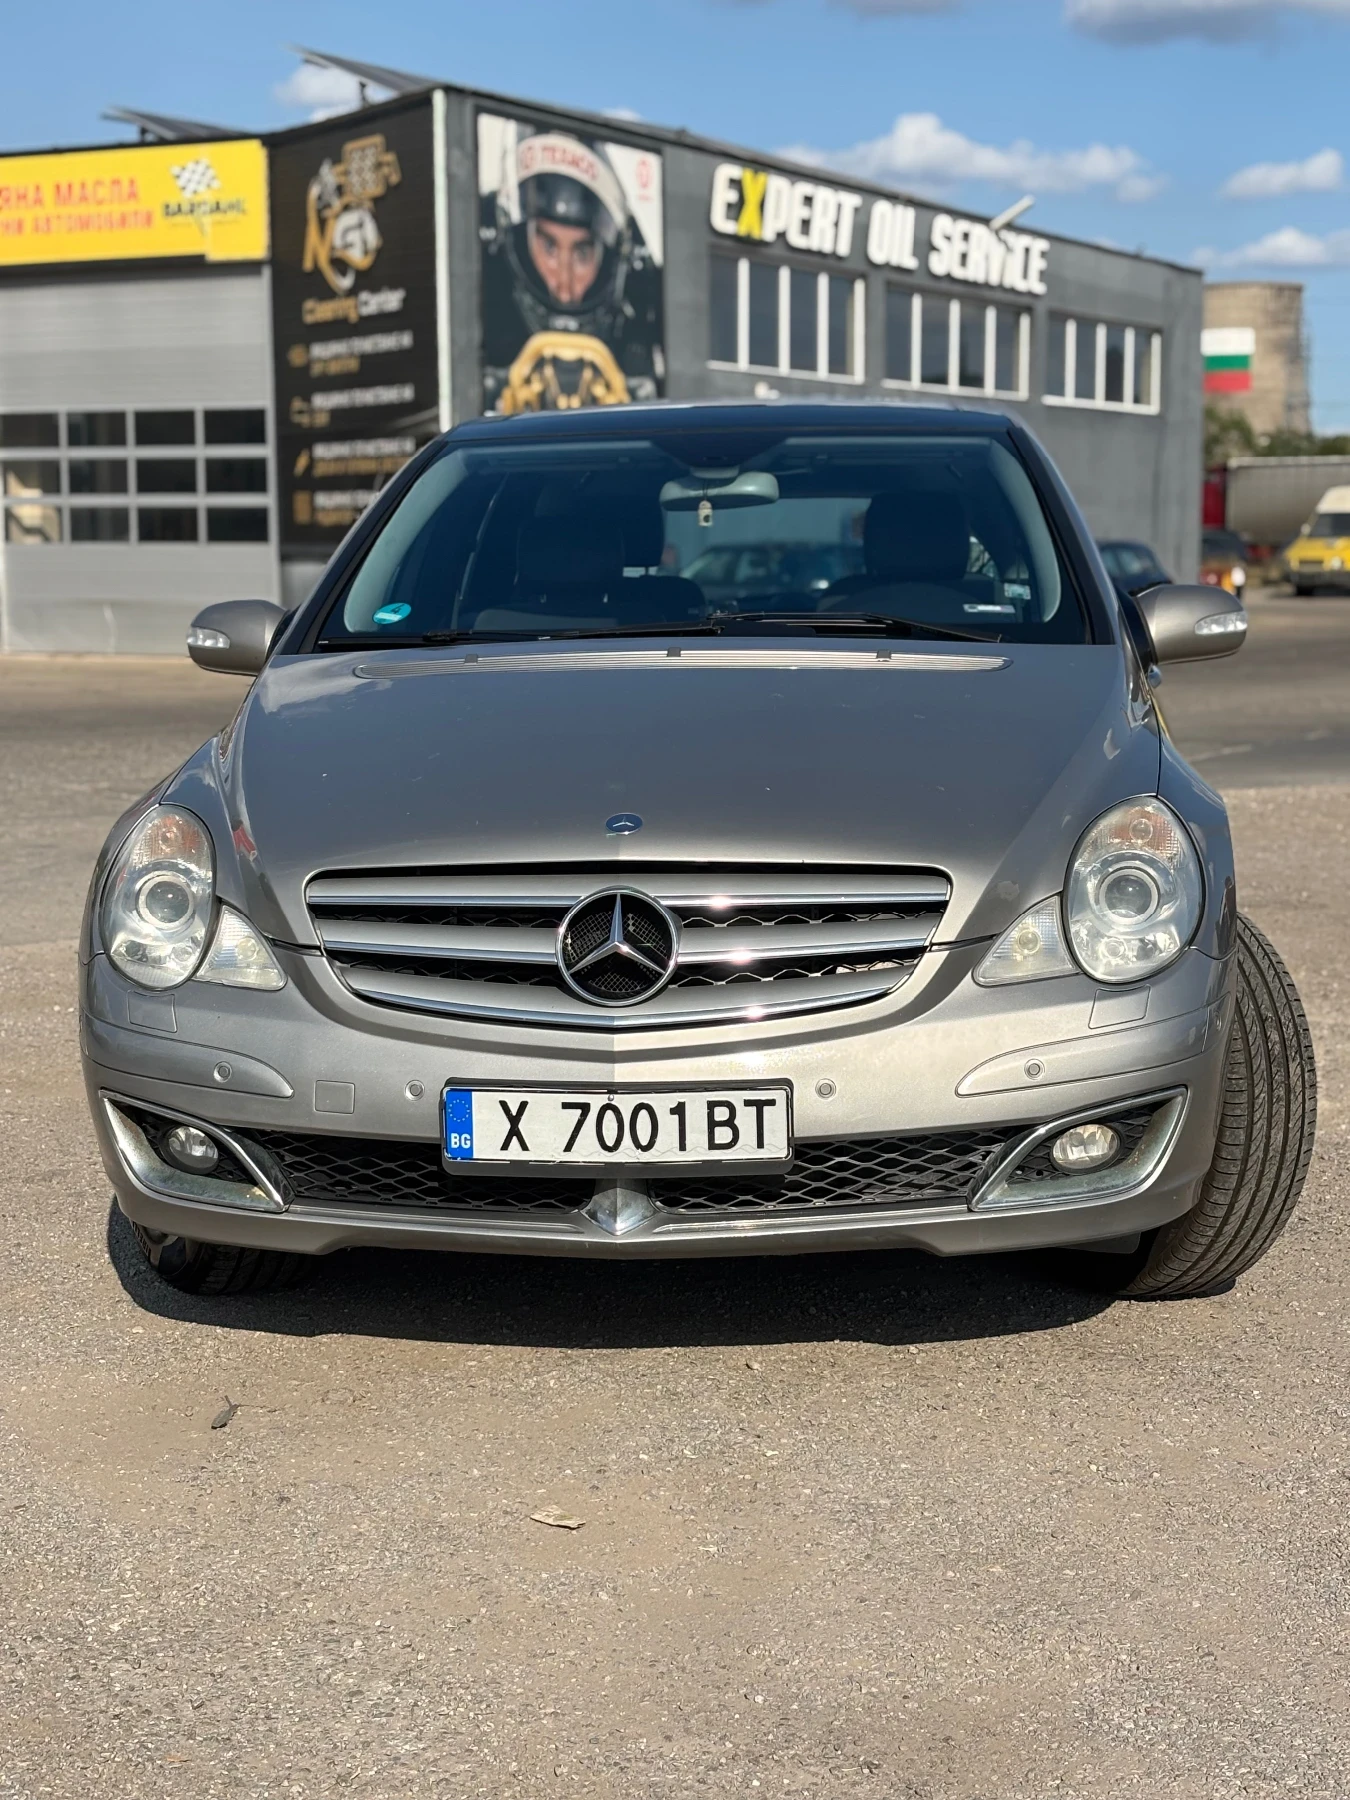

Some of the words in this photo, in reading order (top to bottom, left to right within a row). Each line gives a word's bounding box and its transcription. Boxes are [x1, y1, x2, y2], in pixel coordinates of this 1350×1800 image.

[54, 178, 139, 207] МАСЛА
[710, 162, 863, 258] EXPERT
[867, 199, 920, 271] OIL
[928, 213, 1050, 296] SERVICE
[450, 1133, 471, 1149] BG
